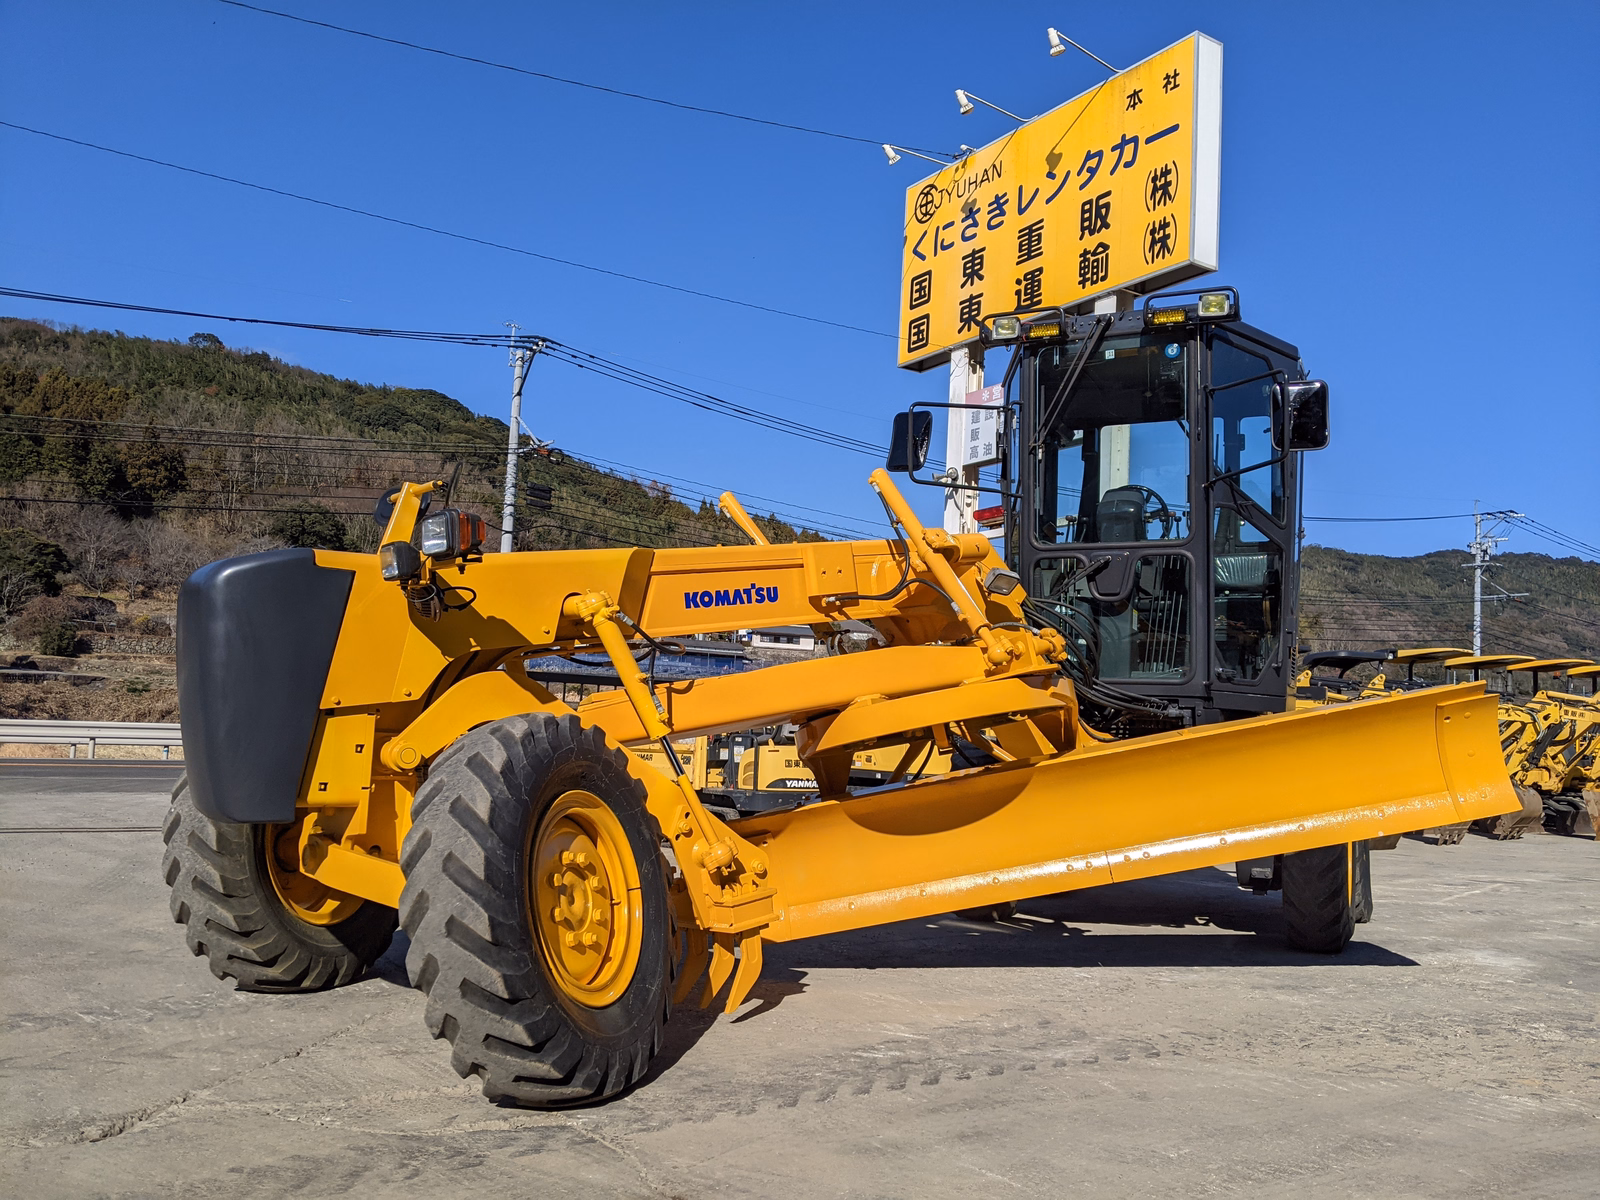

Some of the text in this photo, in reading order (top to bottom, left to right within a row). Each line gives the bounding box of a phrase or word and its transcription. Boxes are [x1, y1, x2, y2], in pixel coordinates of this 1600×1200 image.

[1126, 68, 1181, 111] 本社
[912, 123, 1181, 261] くにさきレンタカー
[934, 160, 1003, 209] JYUHAN
[684, 583, 779, 609] KOMATSU
[634, 753, 654, 762] NMAR
